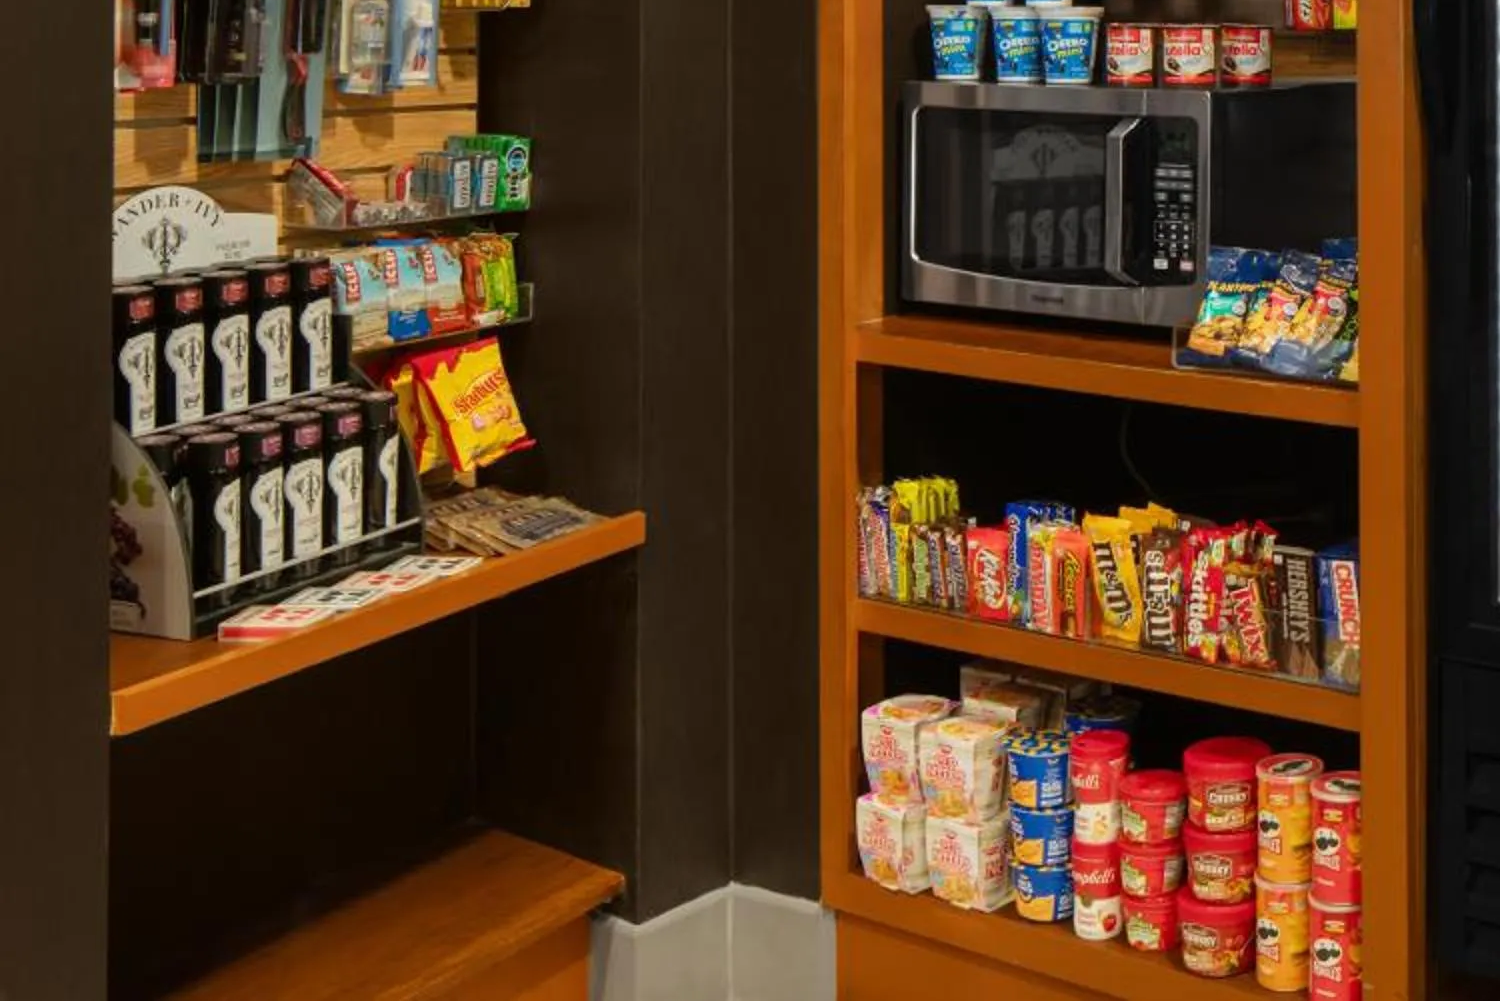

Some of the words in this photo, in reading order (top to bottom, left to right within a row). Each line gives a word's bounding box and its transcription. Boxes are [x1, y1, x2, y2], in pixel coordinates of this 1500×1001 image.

[345, 263, 361, 303] CLIF
[383, 249, 398, 287] CLIF
[423, 249, 438, 283] CLIF
[1030, 542, 1048, 629] PAYDAY
[1285, 557, 1311, 643] HERSHEY'S
[1334, 561, 1361, 649] CRUNCH
